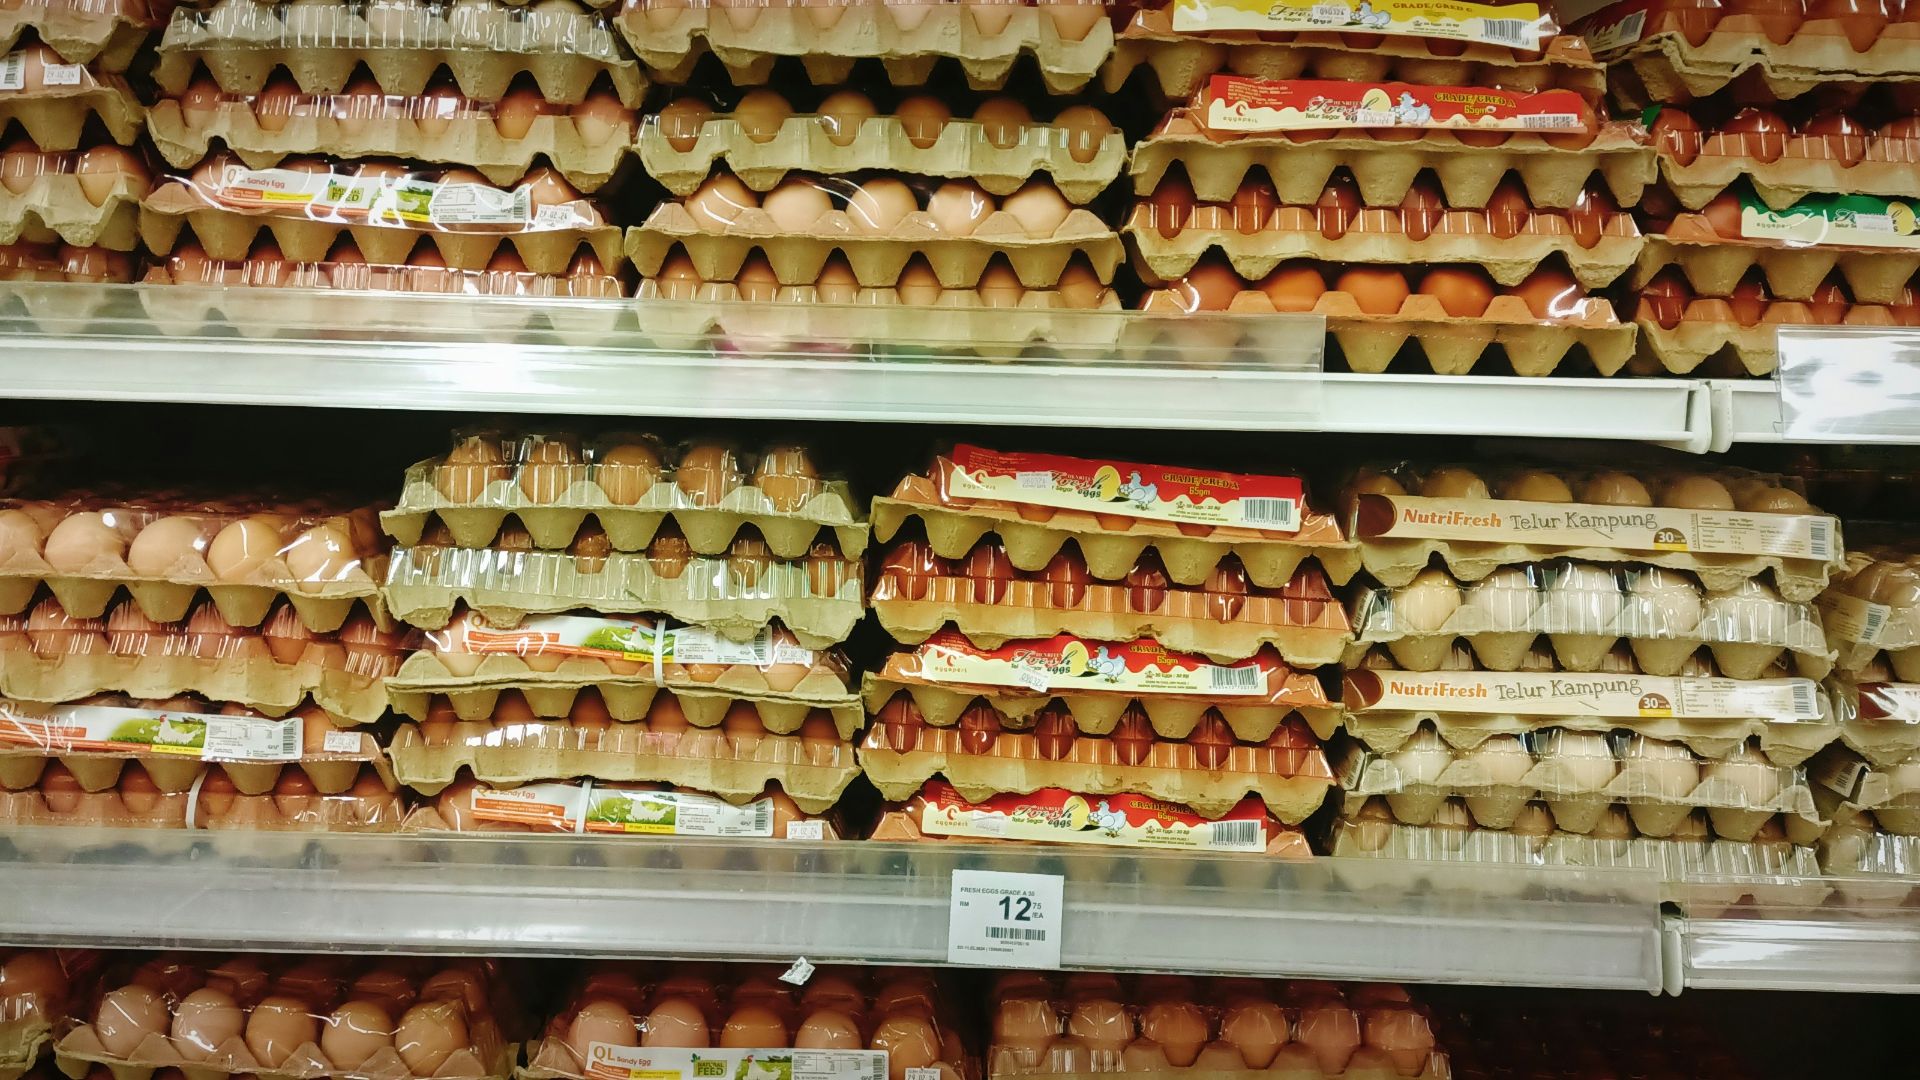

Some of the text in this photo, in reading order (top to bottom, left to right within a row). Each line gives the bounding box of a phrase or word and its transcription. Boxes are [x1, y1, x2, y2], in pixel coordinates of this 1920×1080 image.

[1434, 92, 1506, 106] GRADE/GRED
[1321, 113, 1340, 121] Segar
[247, 177, 270, 187] Sandy
[271, 180, 285, 189] Egg
[1162, 473, 1230, 489] GRADE/GRED
[1077, 489, 1102, 498] eggs
[1189, 486, 1211, 496] 65gm
[1402, 508, 1658, 532] NutriFresh Telur Kampung
[1658, 531, 1674, 543] 30
[1156, 655, 1178, 665] 65gm
[1047, 666, 1071, 675] eggs
[1390, 678, 1643, 700] NutriFresh Telur Kampung
[1642, 697, 1658, 709] 30
[521, 791, 536, 800] Egg
[1026, 817, 1044, 825] Segar
[1157, 811, 1179, 821] 65gm
[1048, 819, 1072, 828] eggs
[999, 896, 1031, 921] 12
[593, 1045, 652, 1067] QL Sandy Egg
[697, 1067, 724, 1076] FEED
